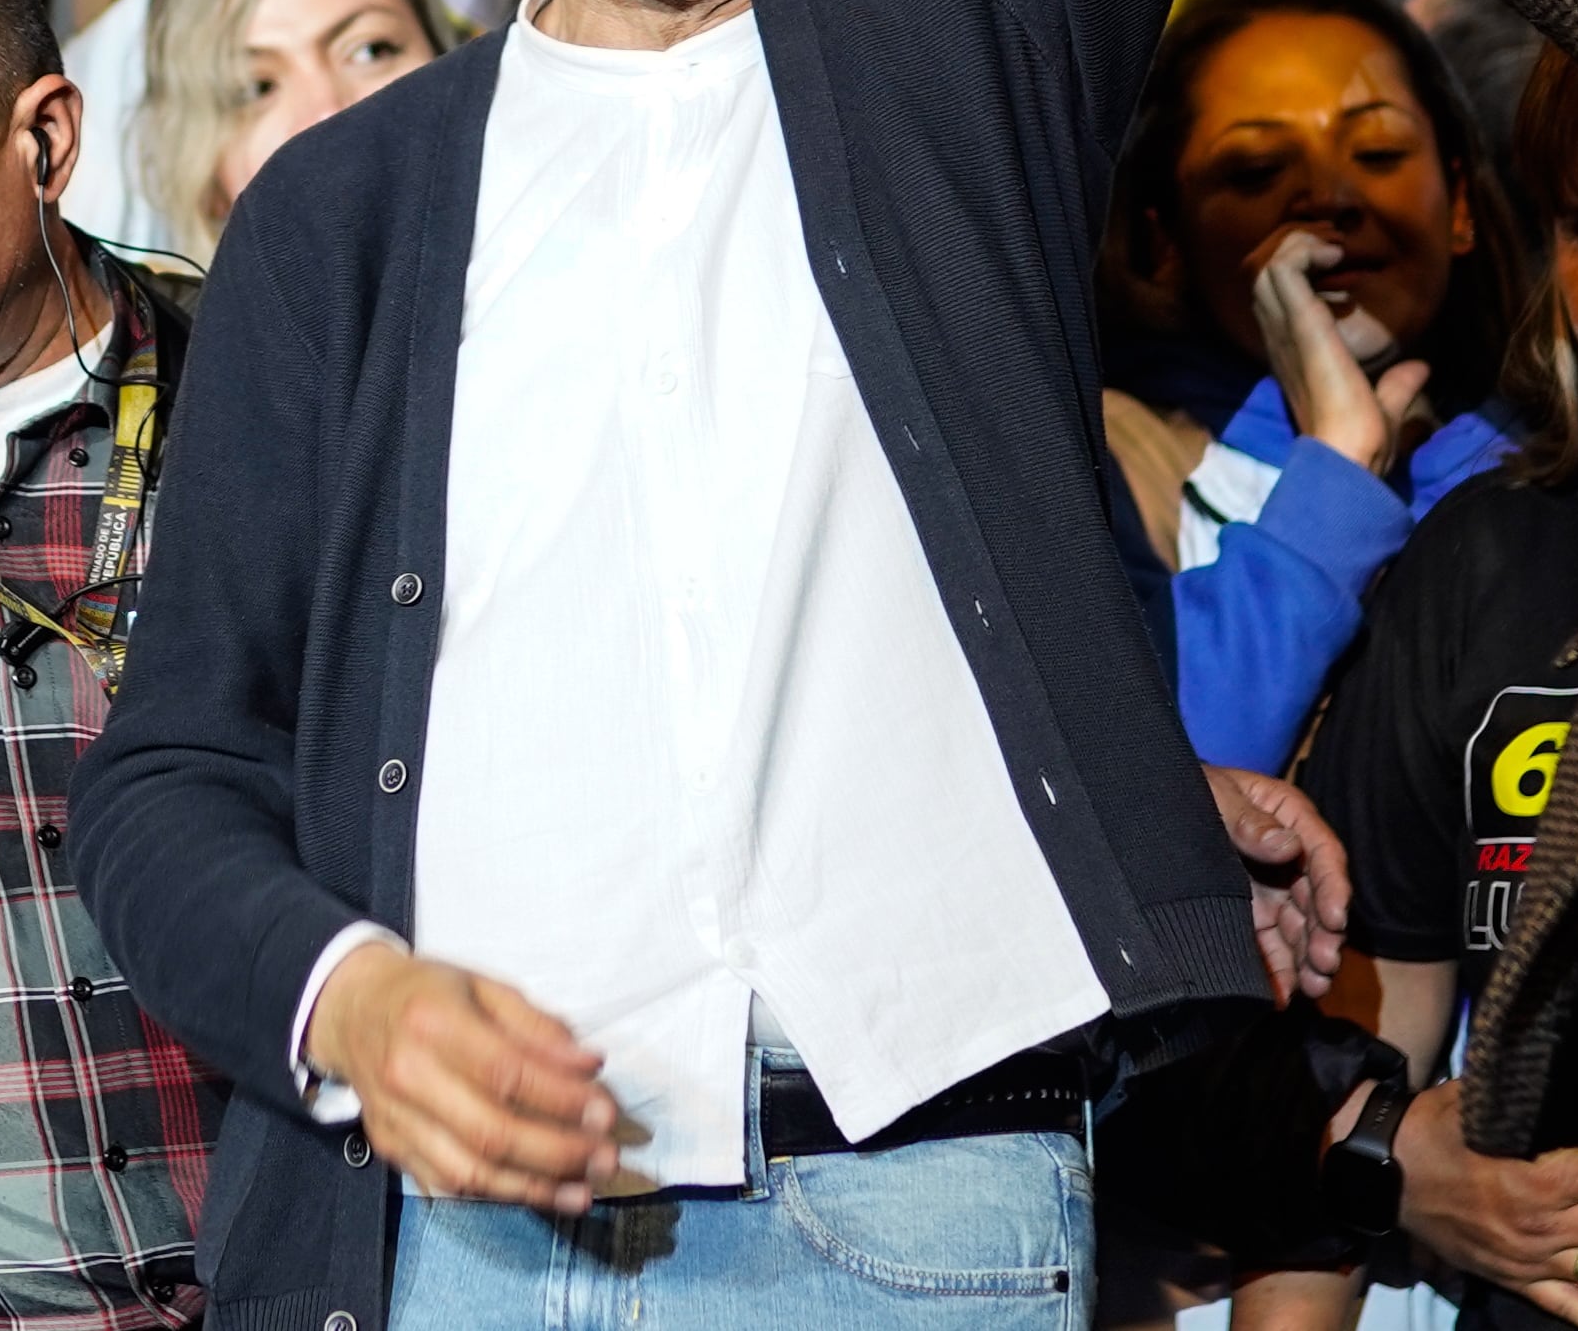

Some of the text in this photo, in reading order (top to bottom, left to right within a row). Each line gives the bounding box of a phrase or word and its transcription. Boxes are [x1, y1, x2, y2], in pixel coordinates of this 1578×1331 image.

[88, 511, 113, 584] SENADO DE LA
